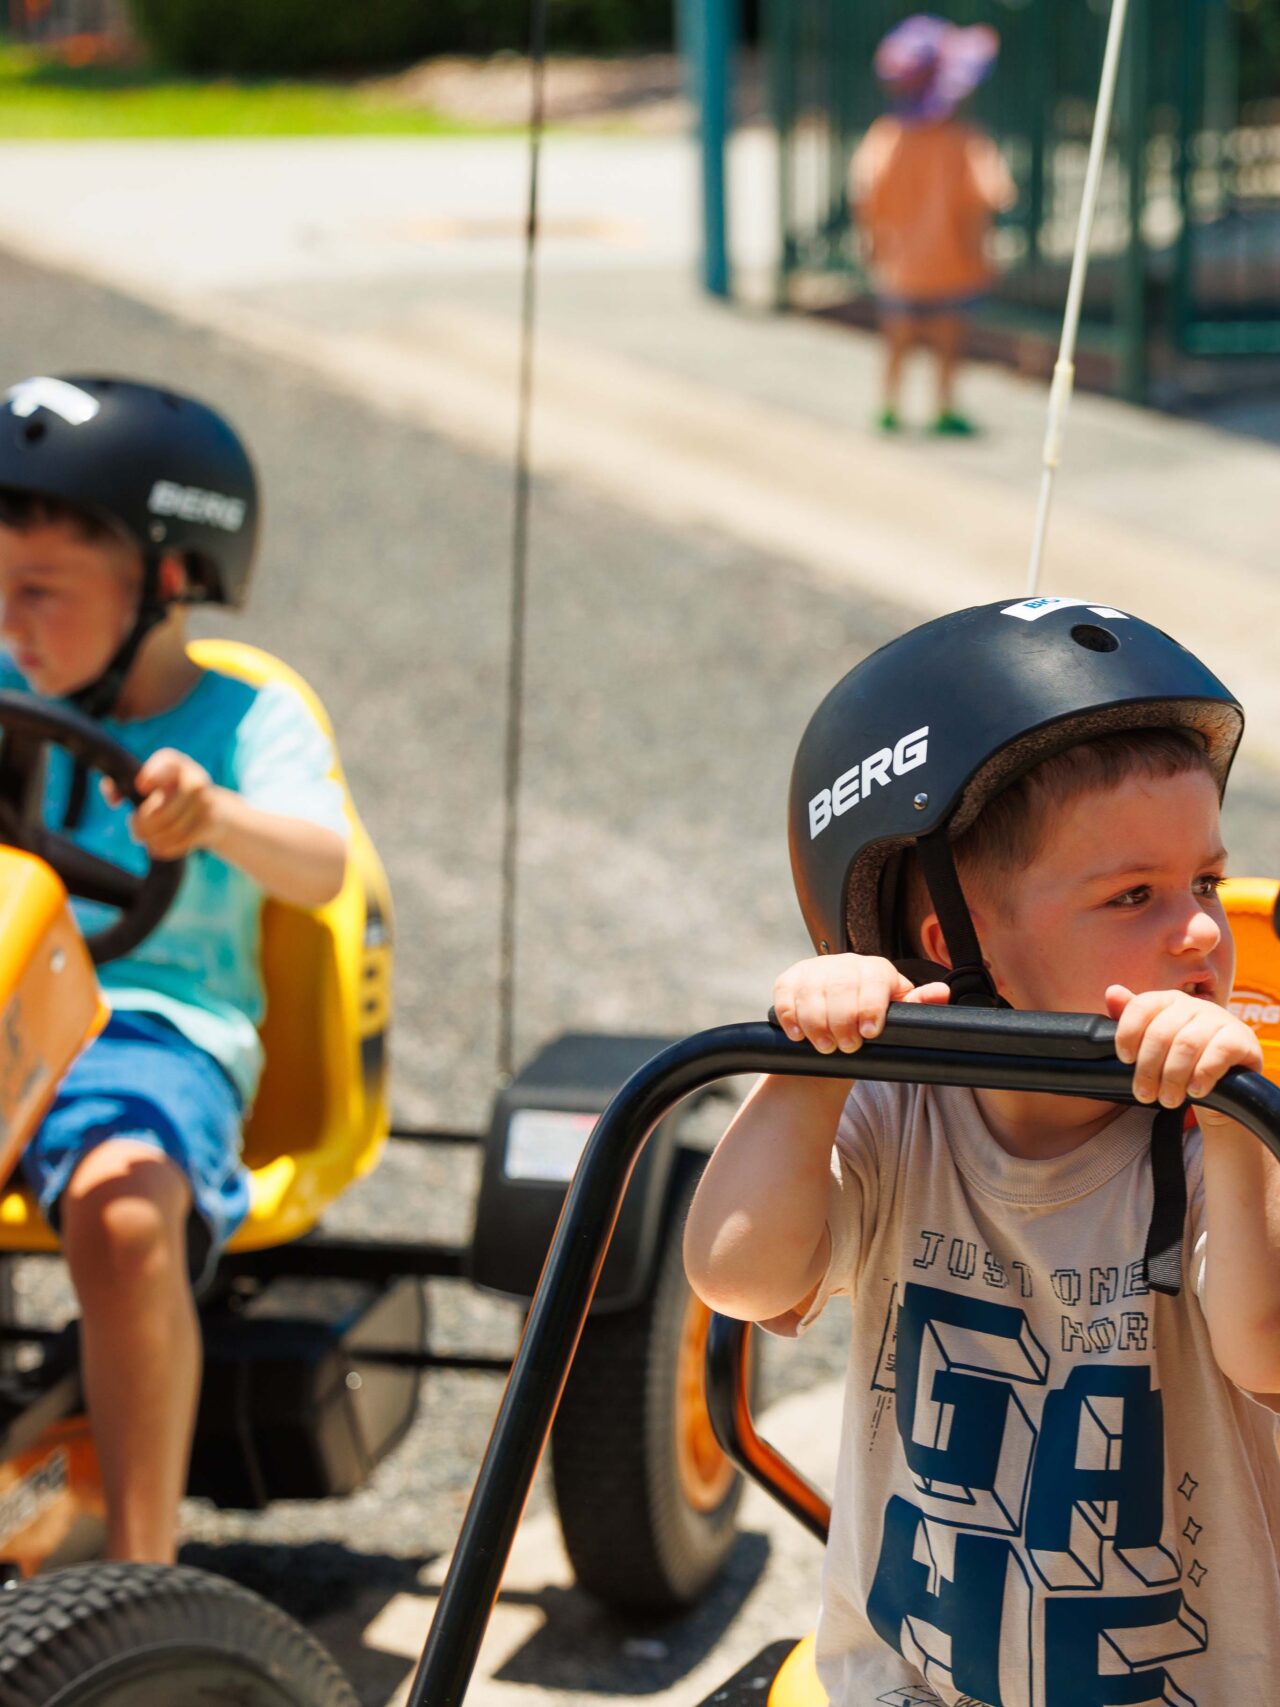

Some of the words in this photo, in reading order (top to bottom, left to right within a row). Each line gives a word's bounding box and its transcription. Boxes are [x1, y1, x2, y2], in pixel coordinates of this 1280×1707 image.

[808, 725, 929, 840] BERG
[913, 1231, 1033, 1297] JUST
[1051, 1258, 1149, 1305] ONE
[1061, 1312, 1150, 1353] MOR
